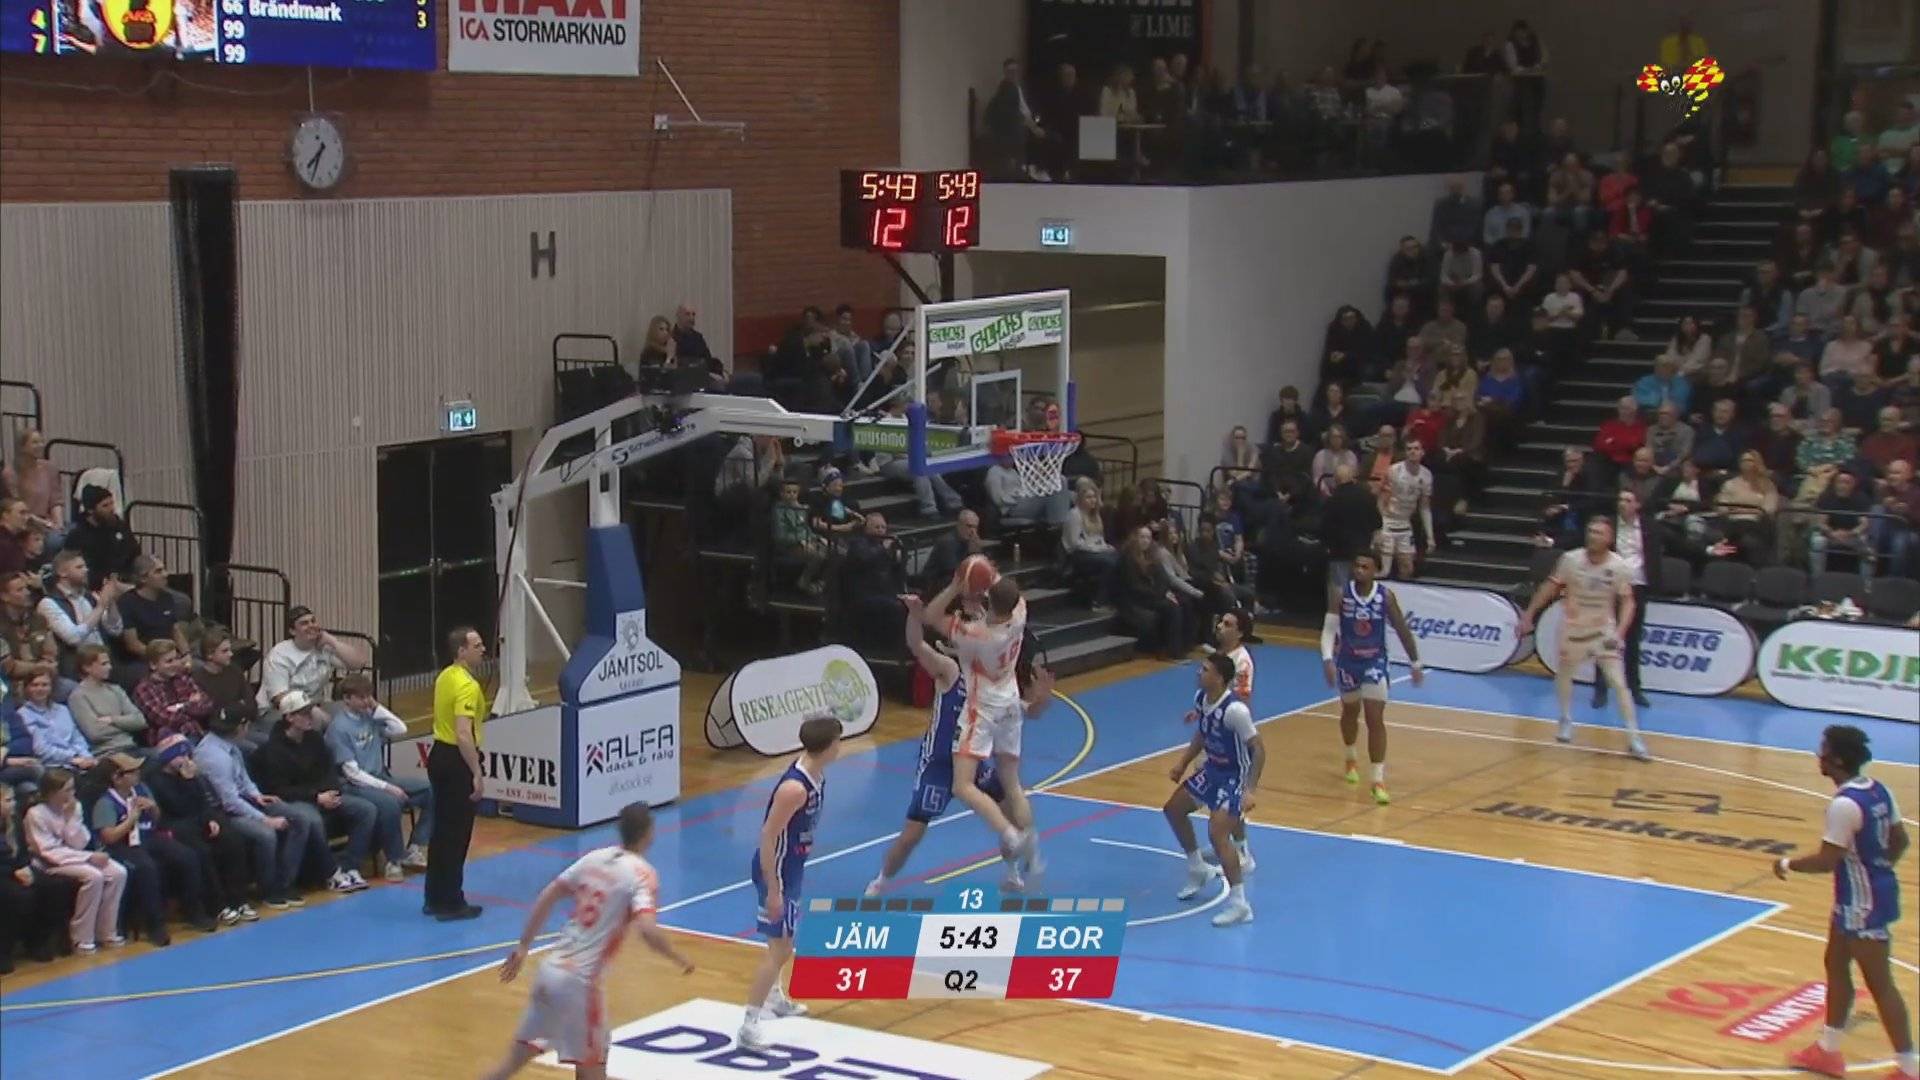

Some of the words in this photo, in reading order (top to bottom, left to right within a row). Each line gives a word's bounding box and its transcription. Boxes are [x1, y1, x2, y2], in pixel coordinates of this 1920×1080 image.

[223, 20, 245, 39] 99
[417, 10, 427, 28] 3
[460, 17, 490, 42] ICA
[493, 18, 627, 46] STORMARKNAD
[224, 44, 246, 63] 99
[862, 173, 917, 200] 5:43
[938, 172, 977, 200] 5:43
[873, 208, 906, 247] 12
[946, 206, 969, 245] 12
[530, 230, 556, 279] H
[854, 430, 906, 448] KUUSAMO
[606, 723, 675, 764] ALFA
